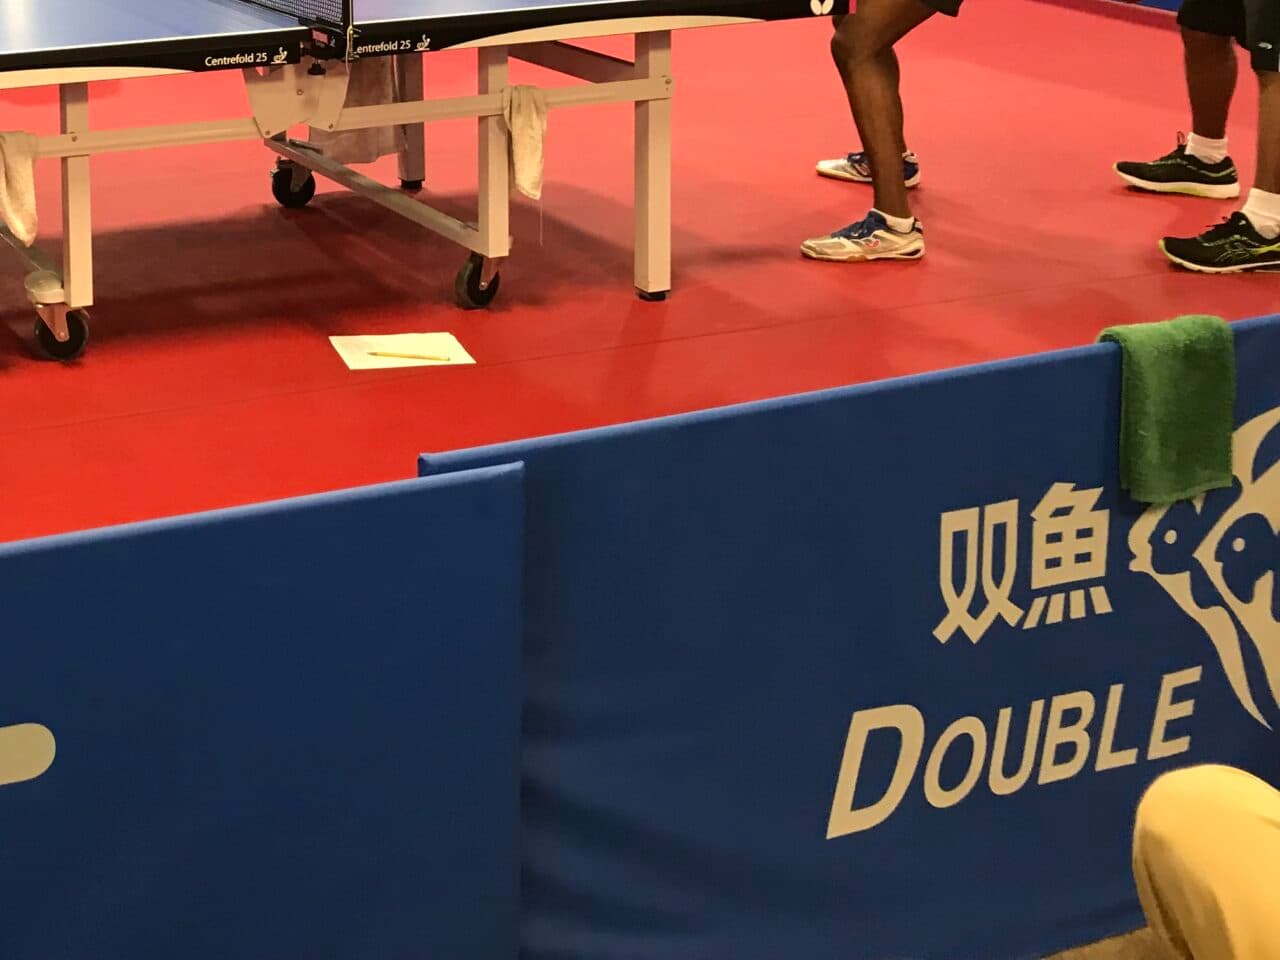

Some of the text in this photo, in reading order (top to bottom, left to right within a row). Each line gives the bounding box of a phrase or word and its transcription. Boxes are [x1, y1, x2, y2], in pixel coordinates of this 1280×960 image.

[205, 52, 268, 67] Centrefold 25
[356, 39, 411, 54] entrefold 25
[932, 481, 1113, 644] 双魚
[826, 665, 1203, 840] DOUBLE
